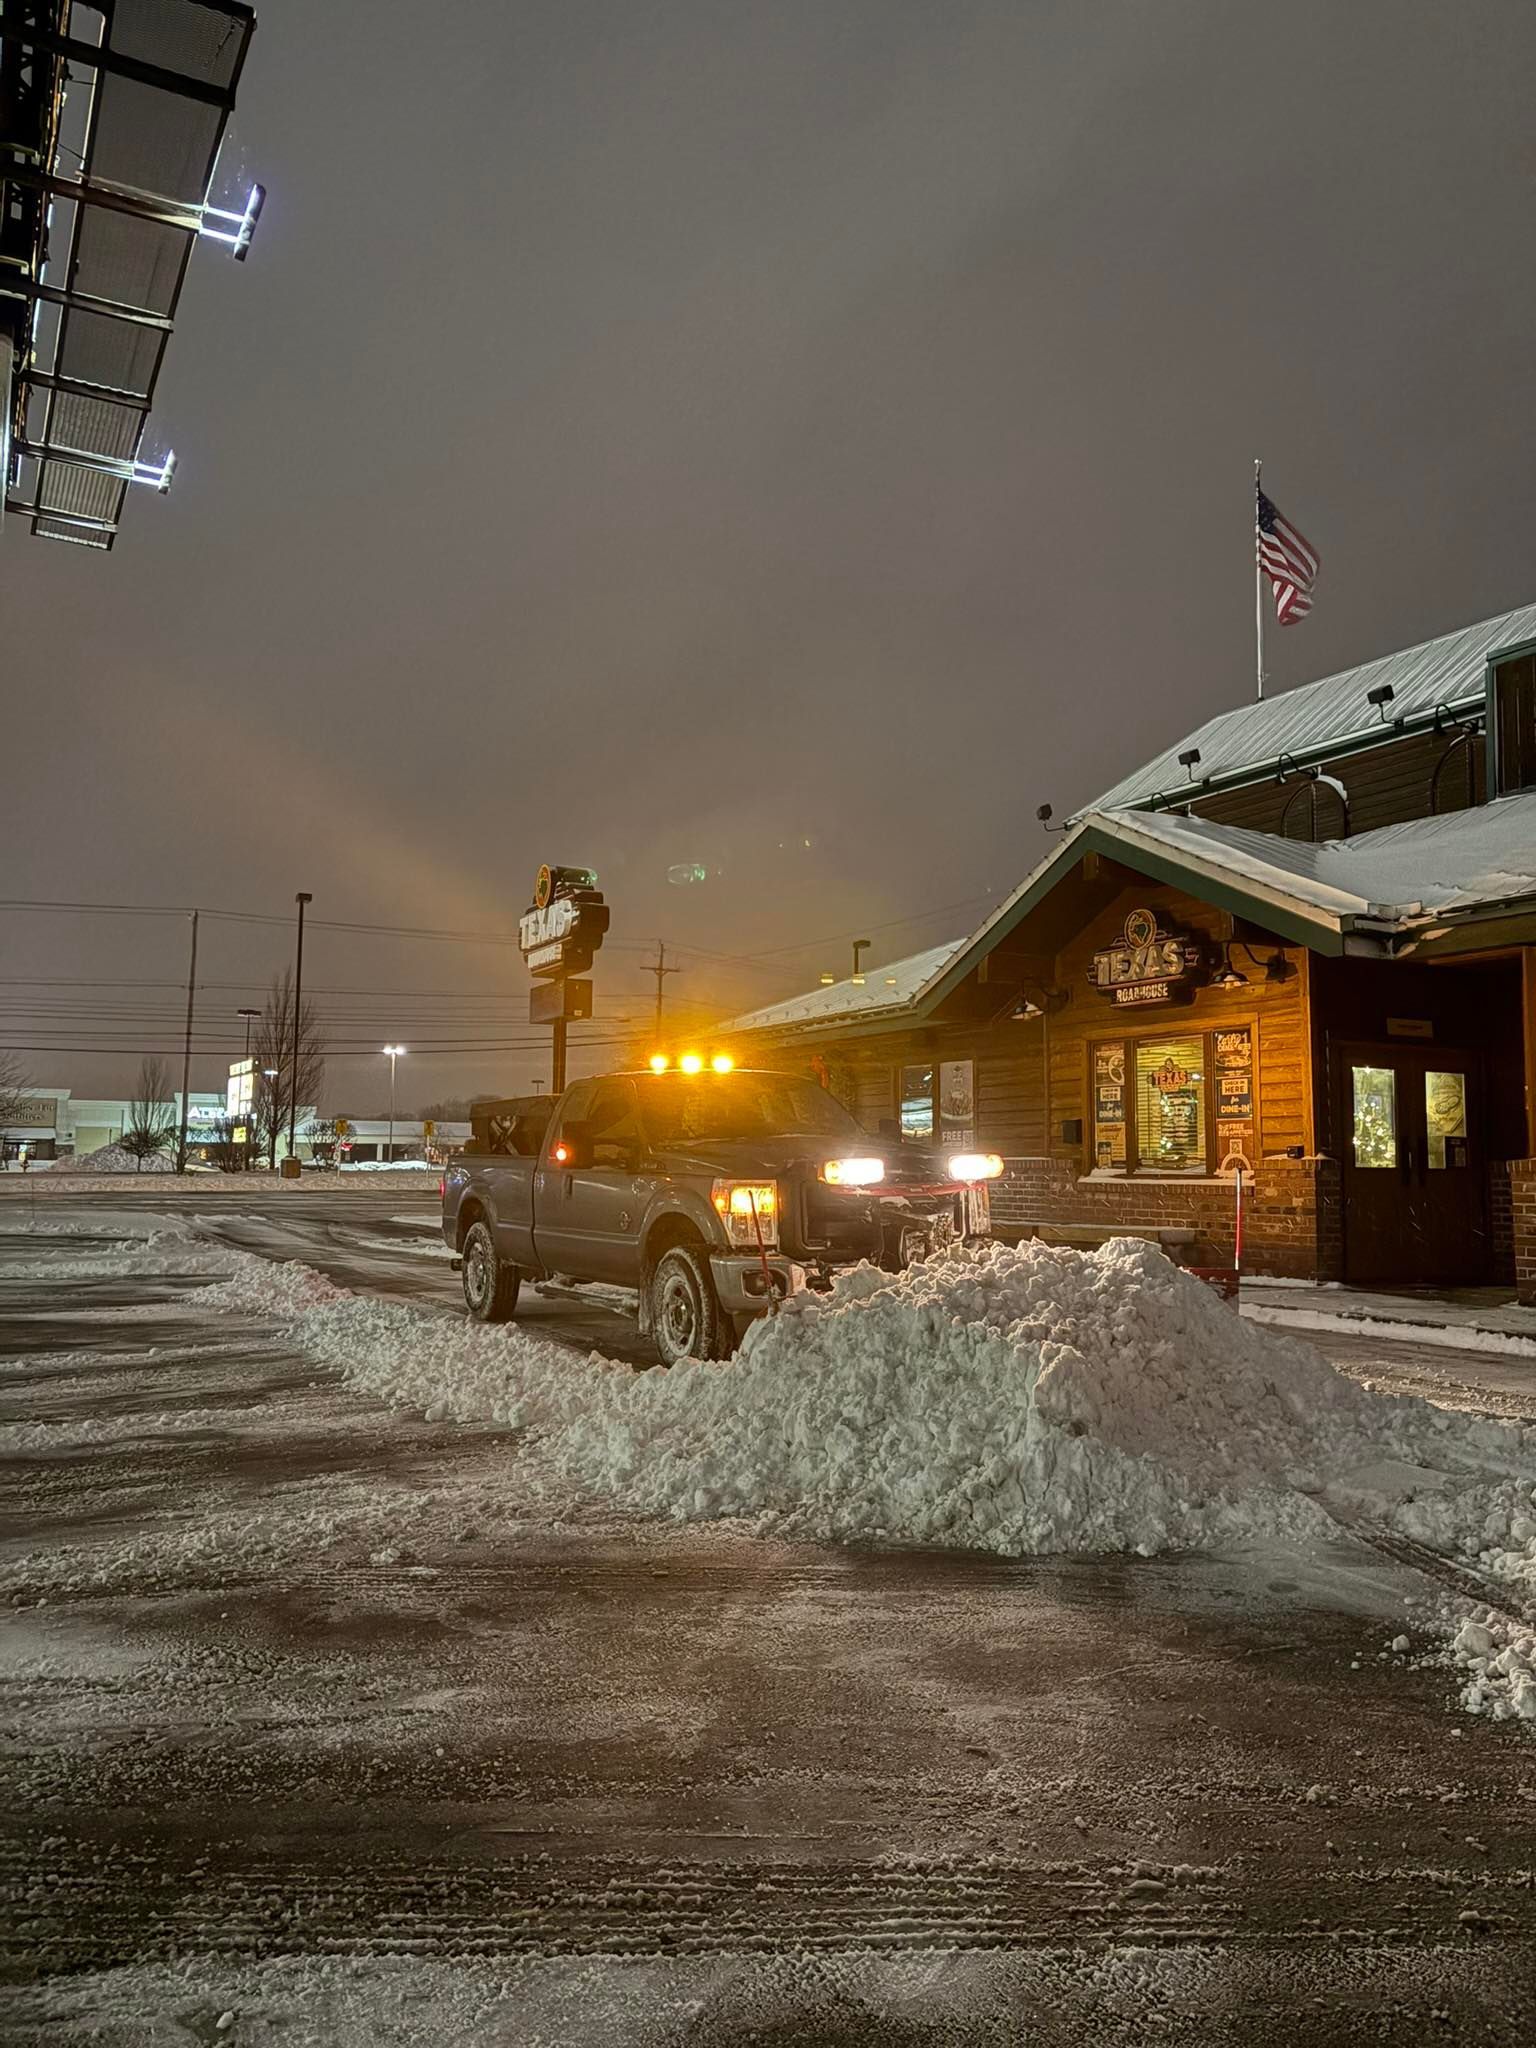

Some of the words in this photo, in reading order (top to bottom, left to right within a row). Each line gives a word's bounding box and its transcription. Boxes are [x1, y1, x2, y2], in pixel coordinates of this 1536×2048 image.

[520, 900, 572, 949] TEXAS
[1093, 941, 1184, 986] TEXAS
[1116, 982, 1168, 1002] ROADHOUSE
[1153, 1071, 1187, 1085] TEXAS
[1221, 1104, 1250, 1113] DINE-IN
[942, 1131, 962, 1142] FREE
